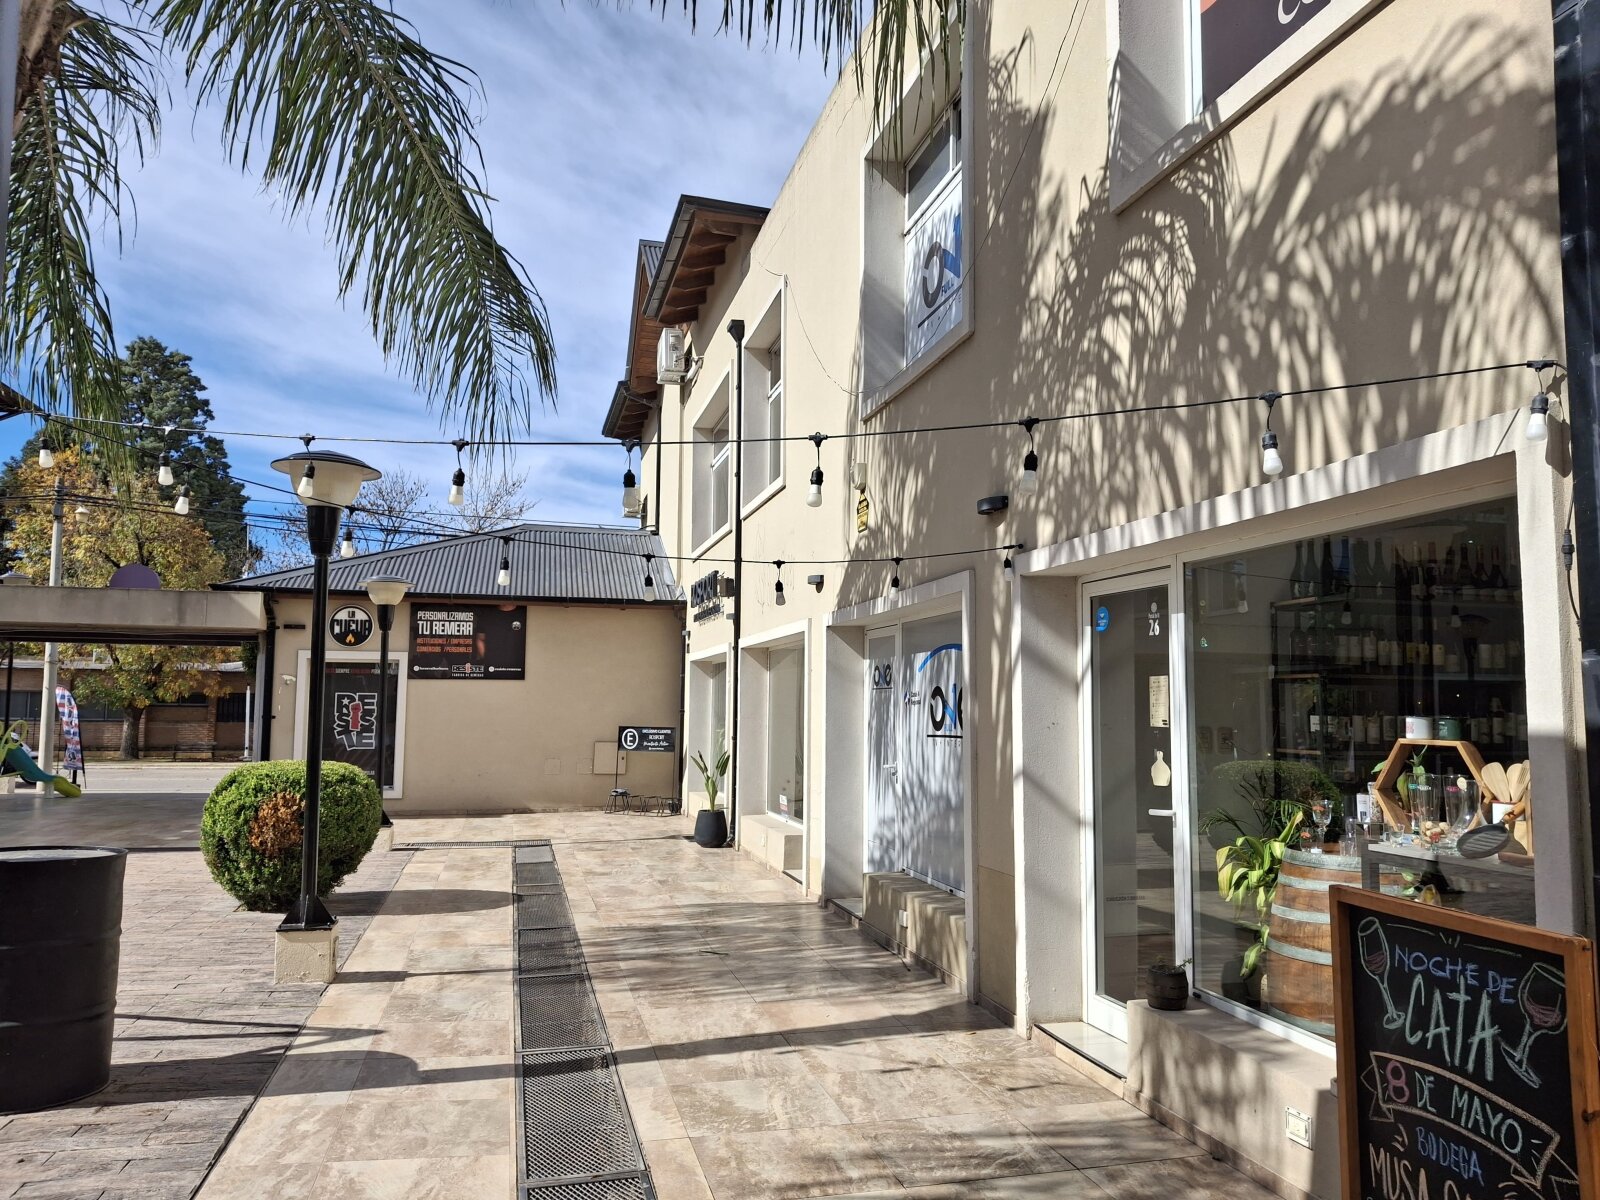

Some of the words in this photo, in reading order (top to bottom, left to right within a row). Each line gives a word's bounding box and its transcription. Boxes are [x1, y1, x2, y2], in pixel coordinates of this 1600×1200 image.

[417, 611, 474, 621] PERSONALIZAMOS
[417, 621, 430, 635] TU
[432, 621, 474, 635] REMERA
[1149, 619, 1160, 636] 26
[627, 732, 634, 746] E
[1395, 945, 1480, 985] NOCHE
[1487, 970, 1518, 1004] DE
[1405, 973, 1501, 1082] CATA
[1385, 1060, 1410, 1104] 8
[1415, 1071, 1438, 1114] DE
[1451, 1084, 1523, 1155] MAYO
[1416, 1126, 1485, 1187] BODEGA
